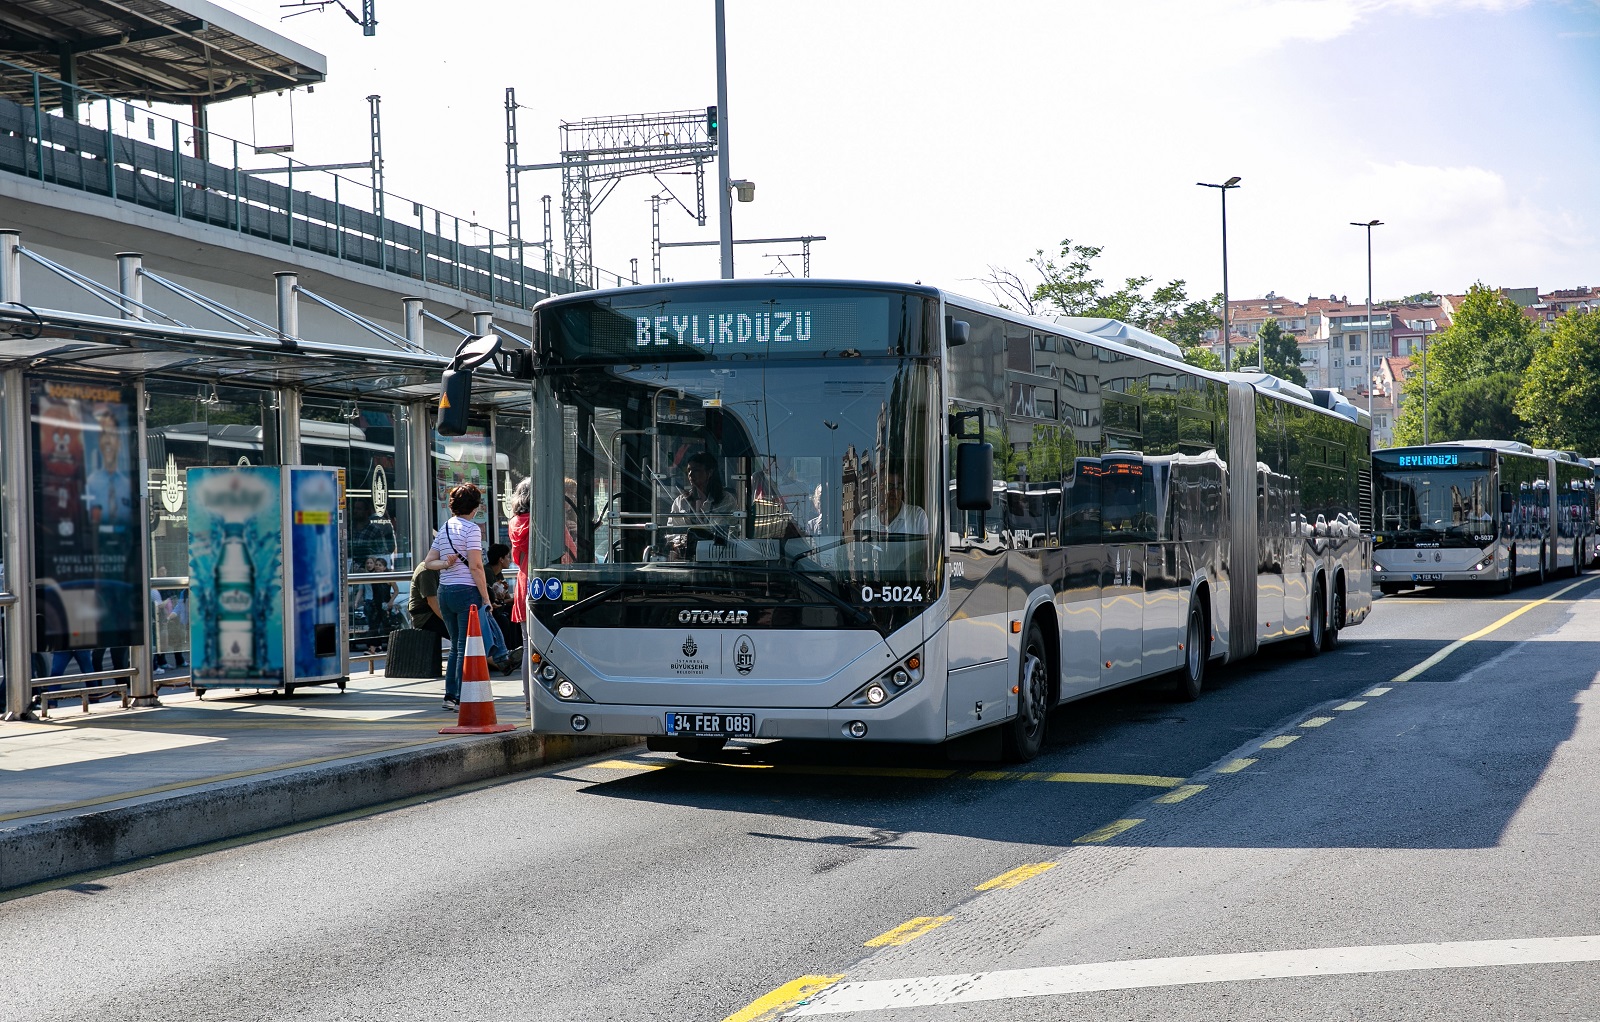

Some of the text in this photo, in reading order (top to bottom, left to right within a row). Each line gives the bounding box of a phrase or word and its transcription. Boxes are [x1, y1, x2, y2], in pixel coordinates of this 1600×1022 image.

[636, 311, 811, 346] BEYLİKDÜZÜ
[1399, 454, 1458, 466] BEYLİKDÜZÜ
[862, 586, 922, 602] O-5024
[678, 610, 748, 623] OTOKAR
[675, 715, 751, 732] 34 FER 089
